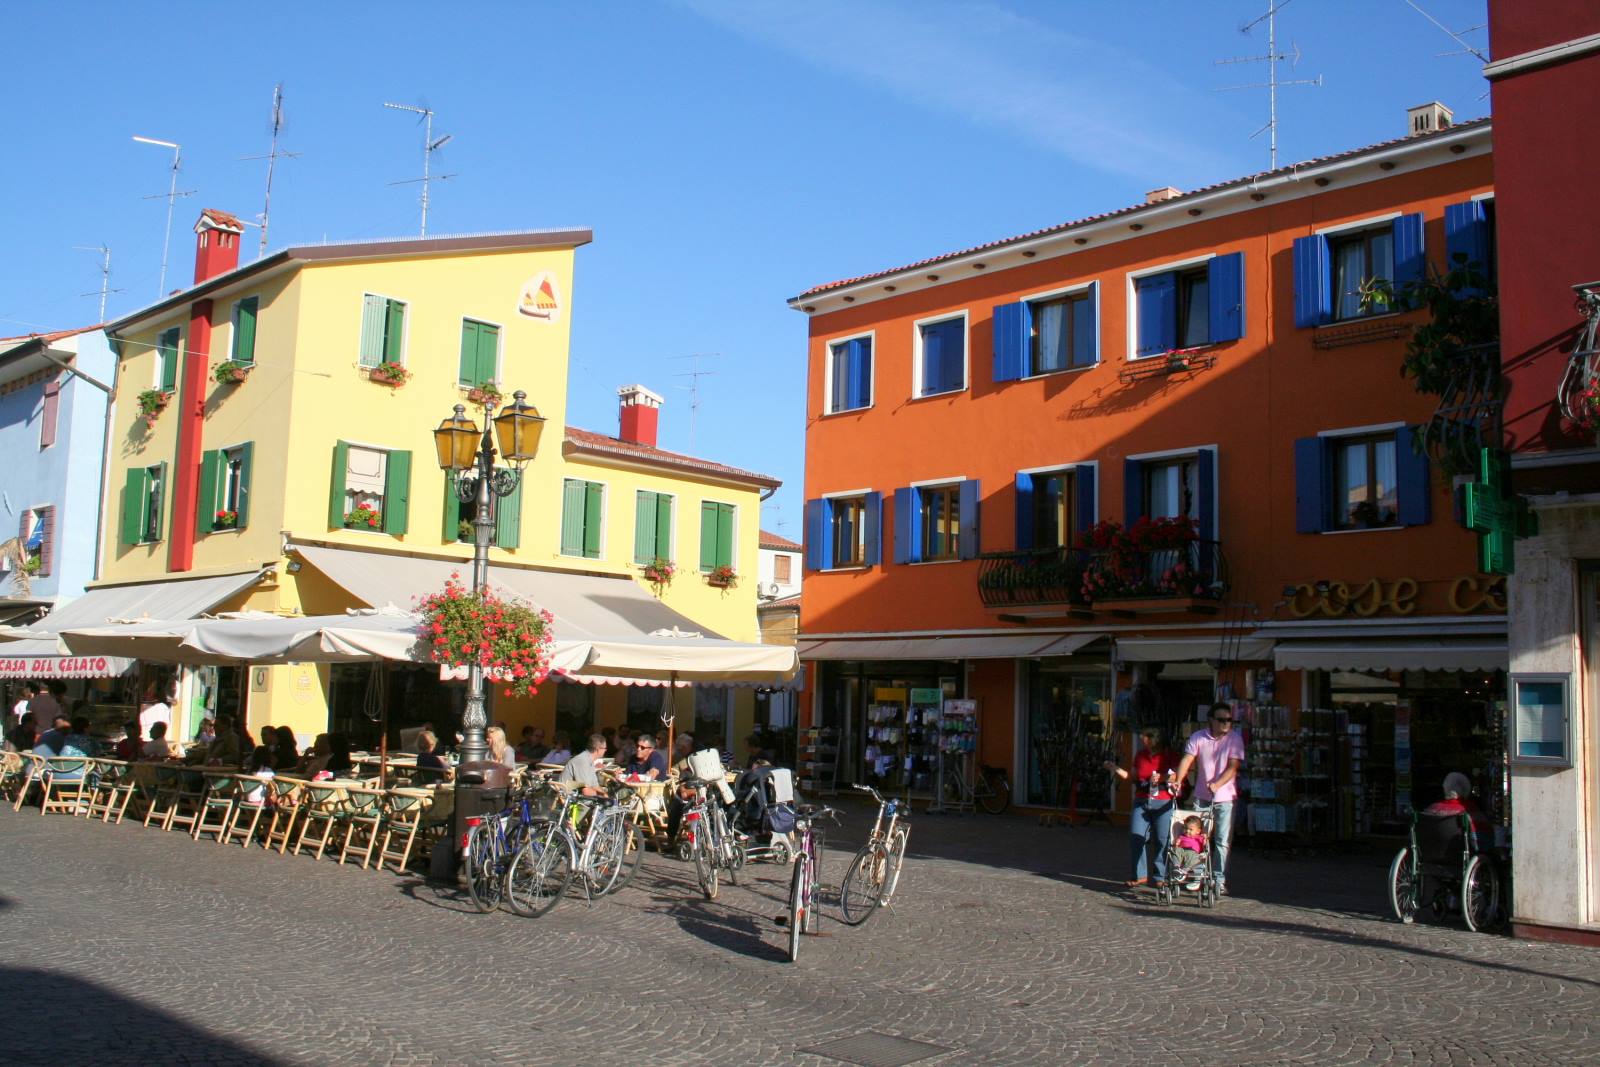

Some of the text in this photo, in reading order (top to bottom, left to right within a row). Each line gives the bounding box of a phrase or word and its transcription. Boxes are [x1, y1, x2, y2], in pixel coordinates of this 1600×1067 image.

[0, 657, 106, 672] CASA DEL GELATO
